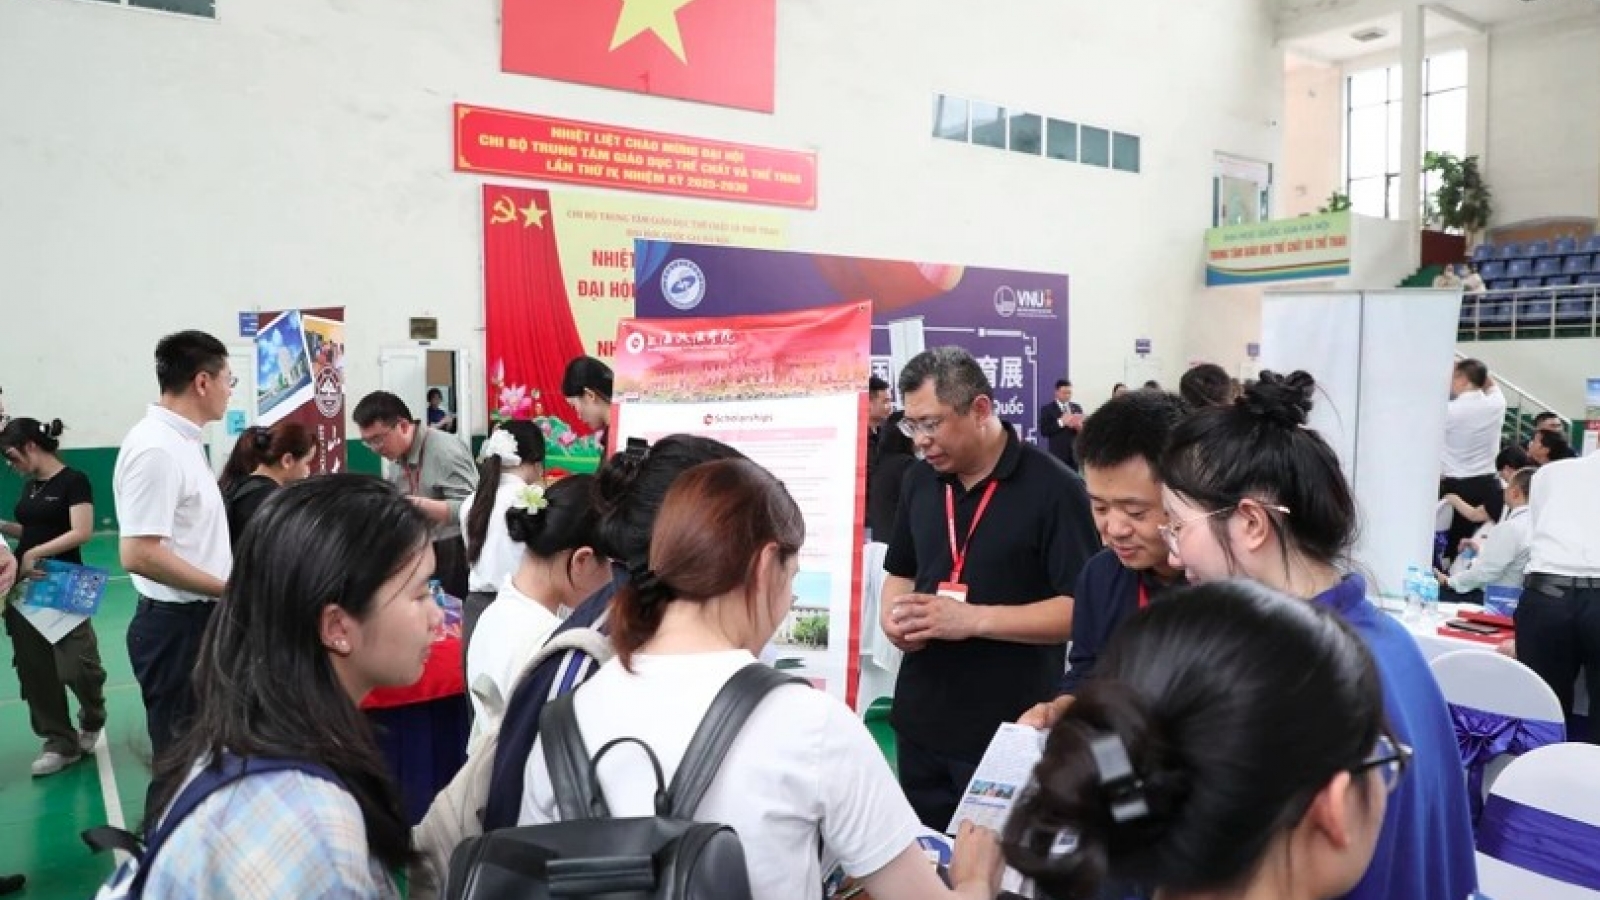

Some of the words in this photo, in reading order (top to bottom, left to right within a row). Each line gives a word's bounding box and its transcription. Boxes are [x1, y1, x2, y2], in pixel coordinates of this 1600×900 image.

[551, 126, 591, 143] NHIỆT
[594, 132, 621, 147] LIỆT
[624, 136, 659, 152] CHÀO
[478, 133, 505, 148] CHI
[507, 136, 528, 153] BỘ
[531, 140, 578, 157] TRUNG
[581, 146, 610, 162] TÂM
[613, 150, 644, 166] GIÁO
[733, 165, 749, 178] VÀ
[623, 168, 665, 185] NHIỆM
[577, 279, 605, 302] ĐẠI
[1016, 289, 1044, 307] VNU
